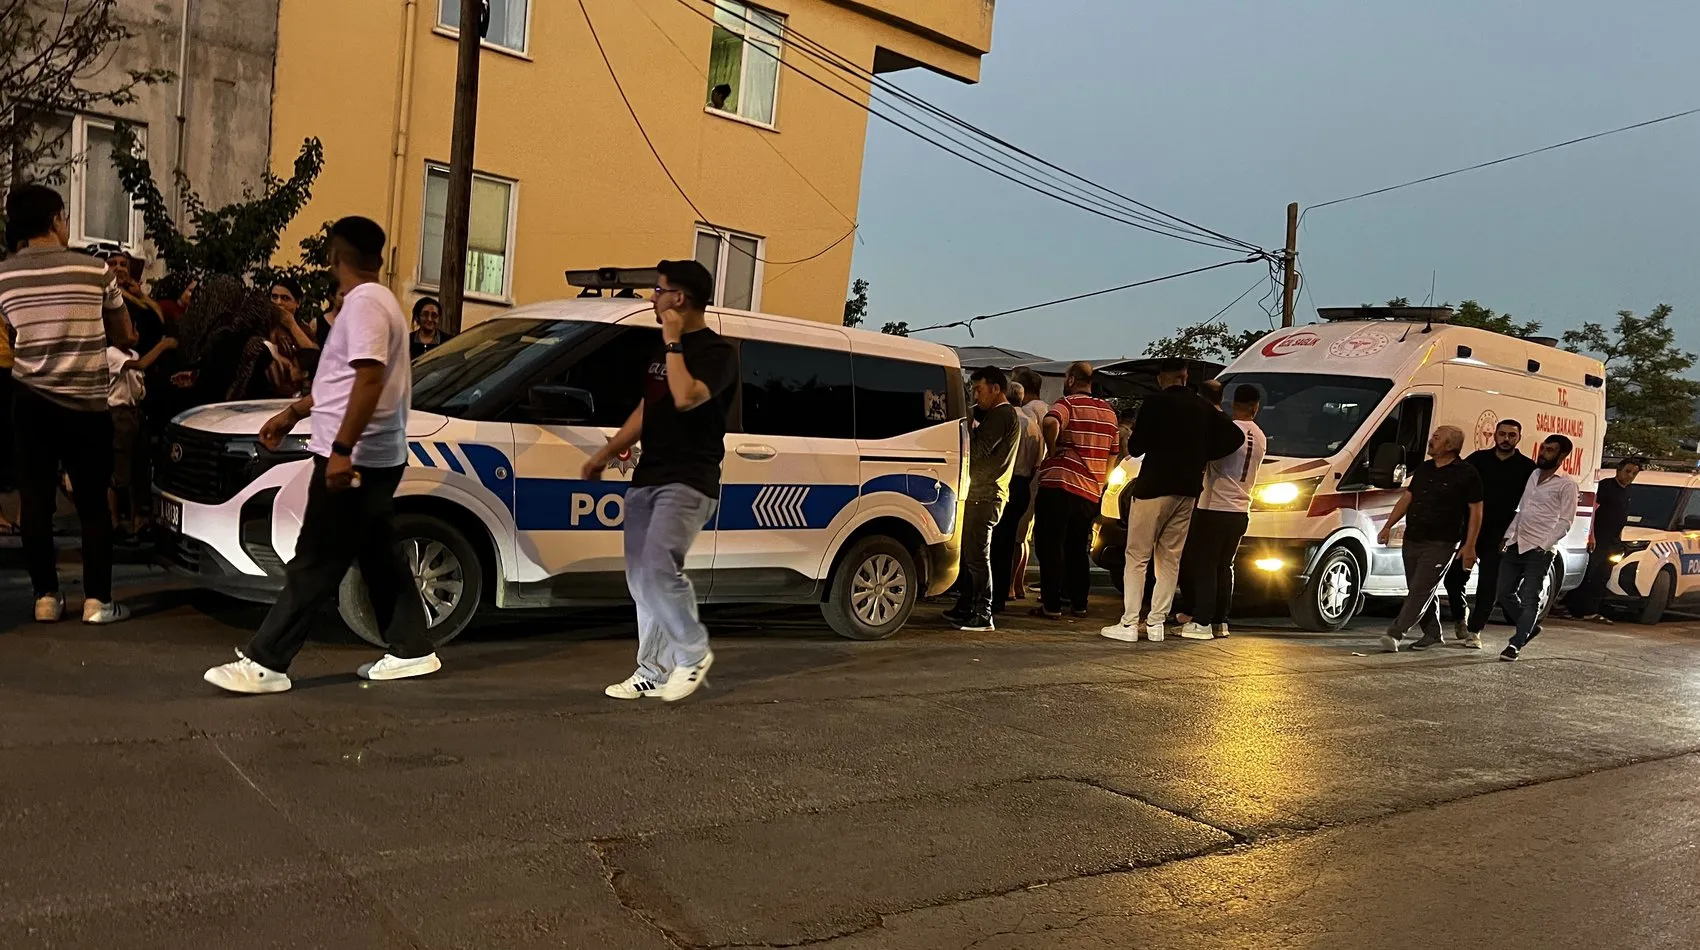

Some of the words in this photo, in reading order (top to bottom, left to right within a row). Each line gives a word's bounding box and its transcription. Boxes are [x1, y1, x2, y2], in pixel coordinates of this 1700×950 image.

[1536, 412, 1556, 433] SAĞLIK
[1557, 416, 1583, 437] BAKANLIĞI
[570, 493, 624, 527] PO
